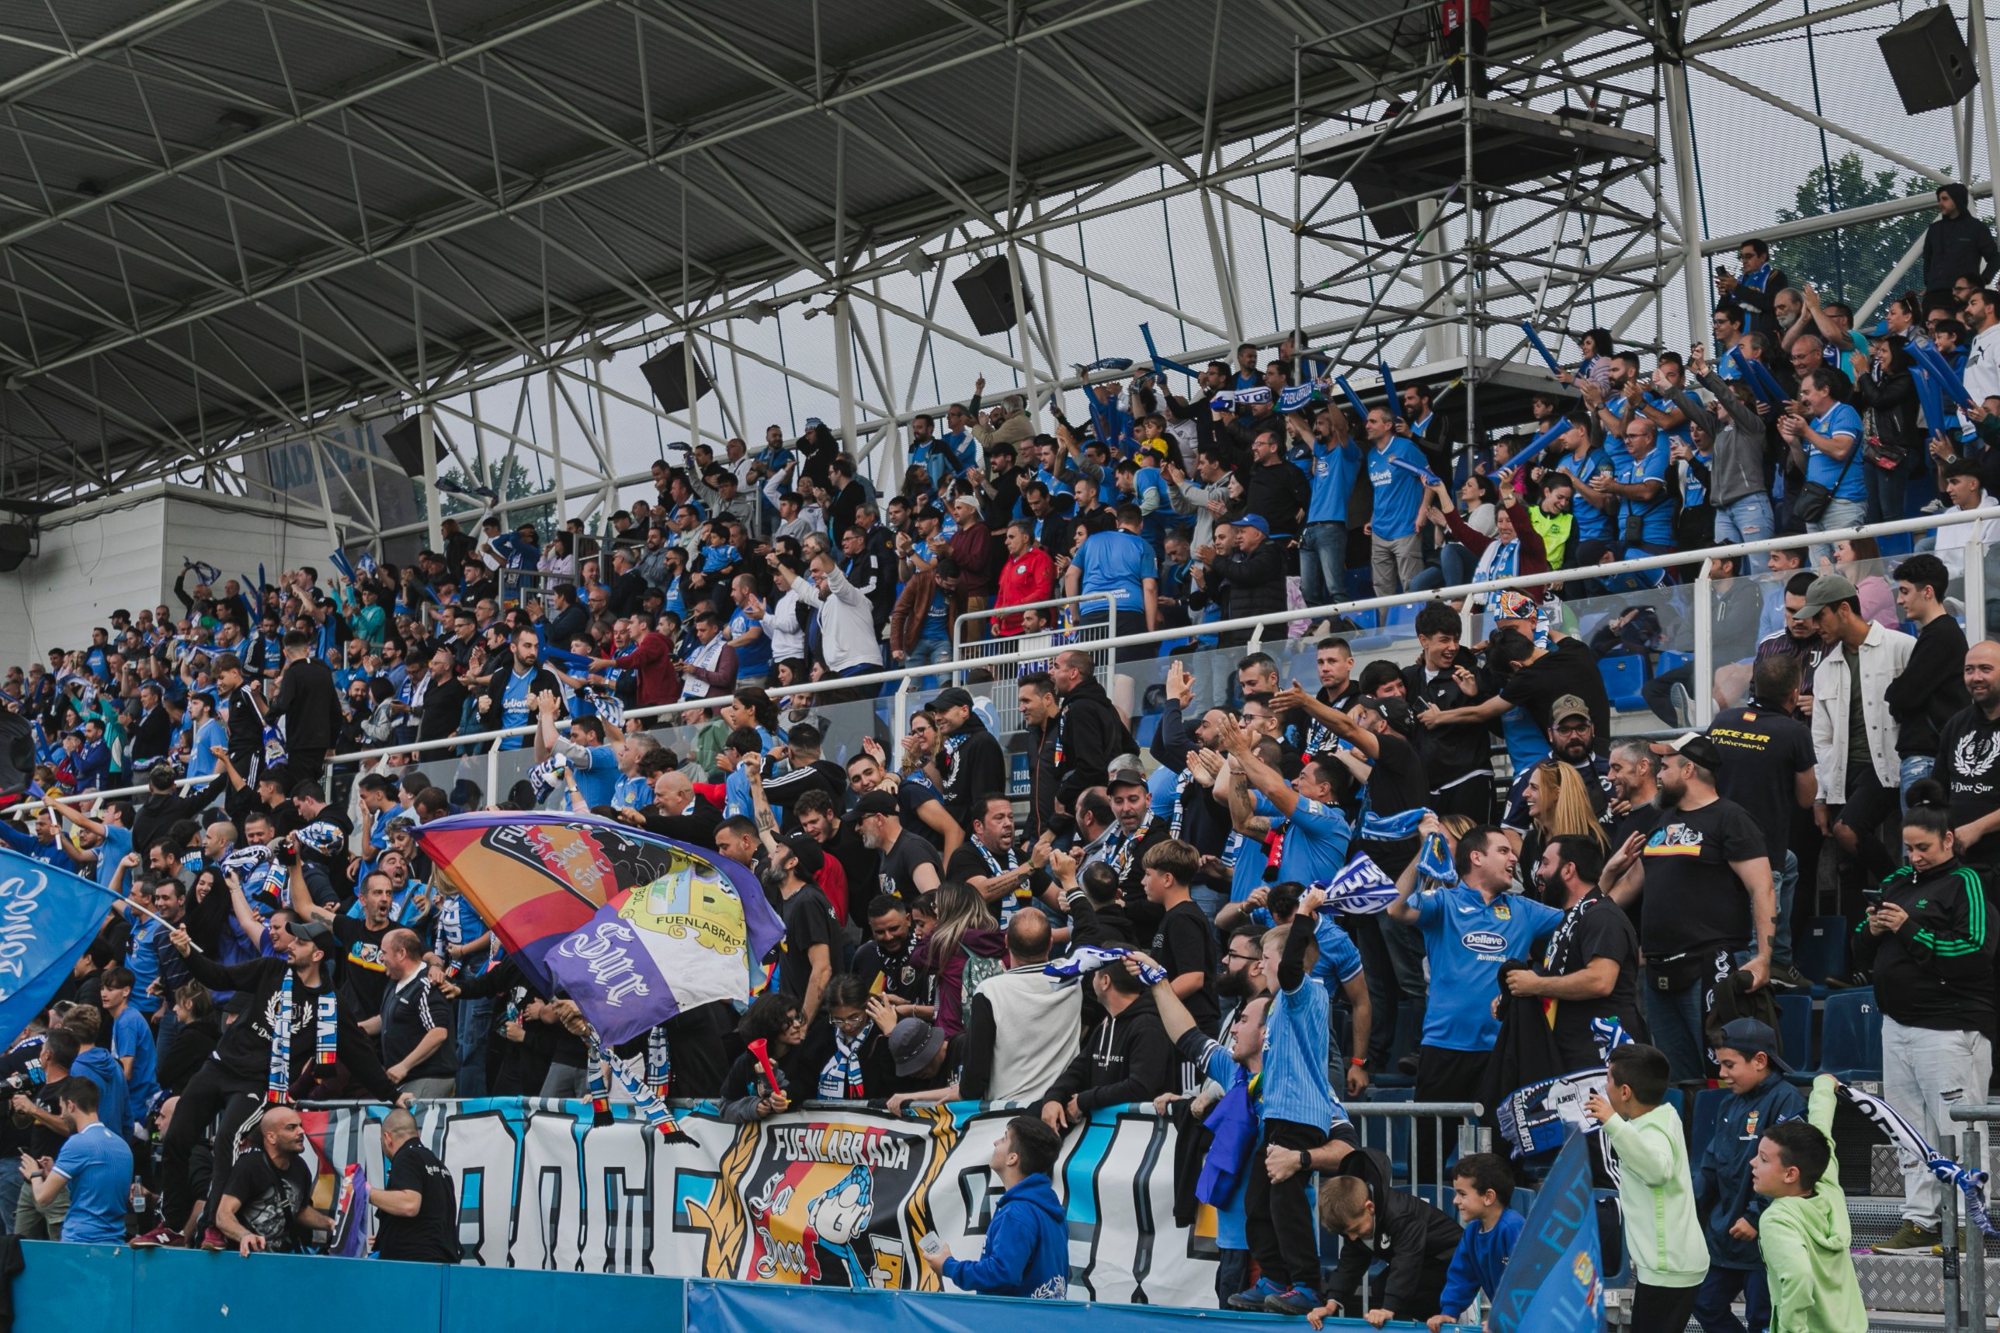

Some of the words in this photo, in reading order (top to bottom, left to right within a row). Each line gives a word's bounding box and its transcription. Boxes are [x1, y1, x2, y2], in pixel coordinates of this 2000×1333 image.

[1741, 733, 1770, 743] SUR
[1973, 782, 1993, 794] Sur
[772, 1127, 911, 1171] FUENLABRADA
[749, 1171, 796, 1219] La
[756, 1225, 810, 1279] Doce
